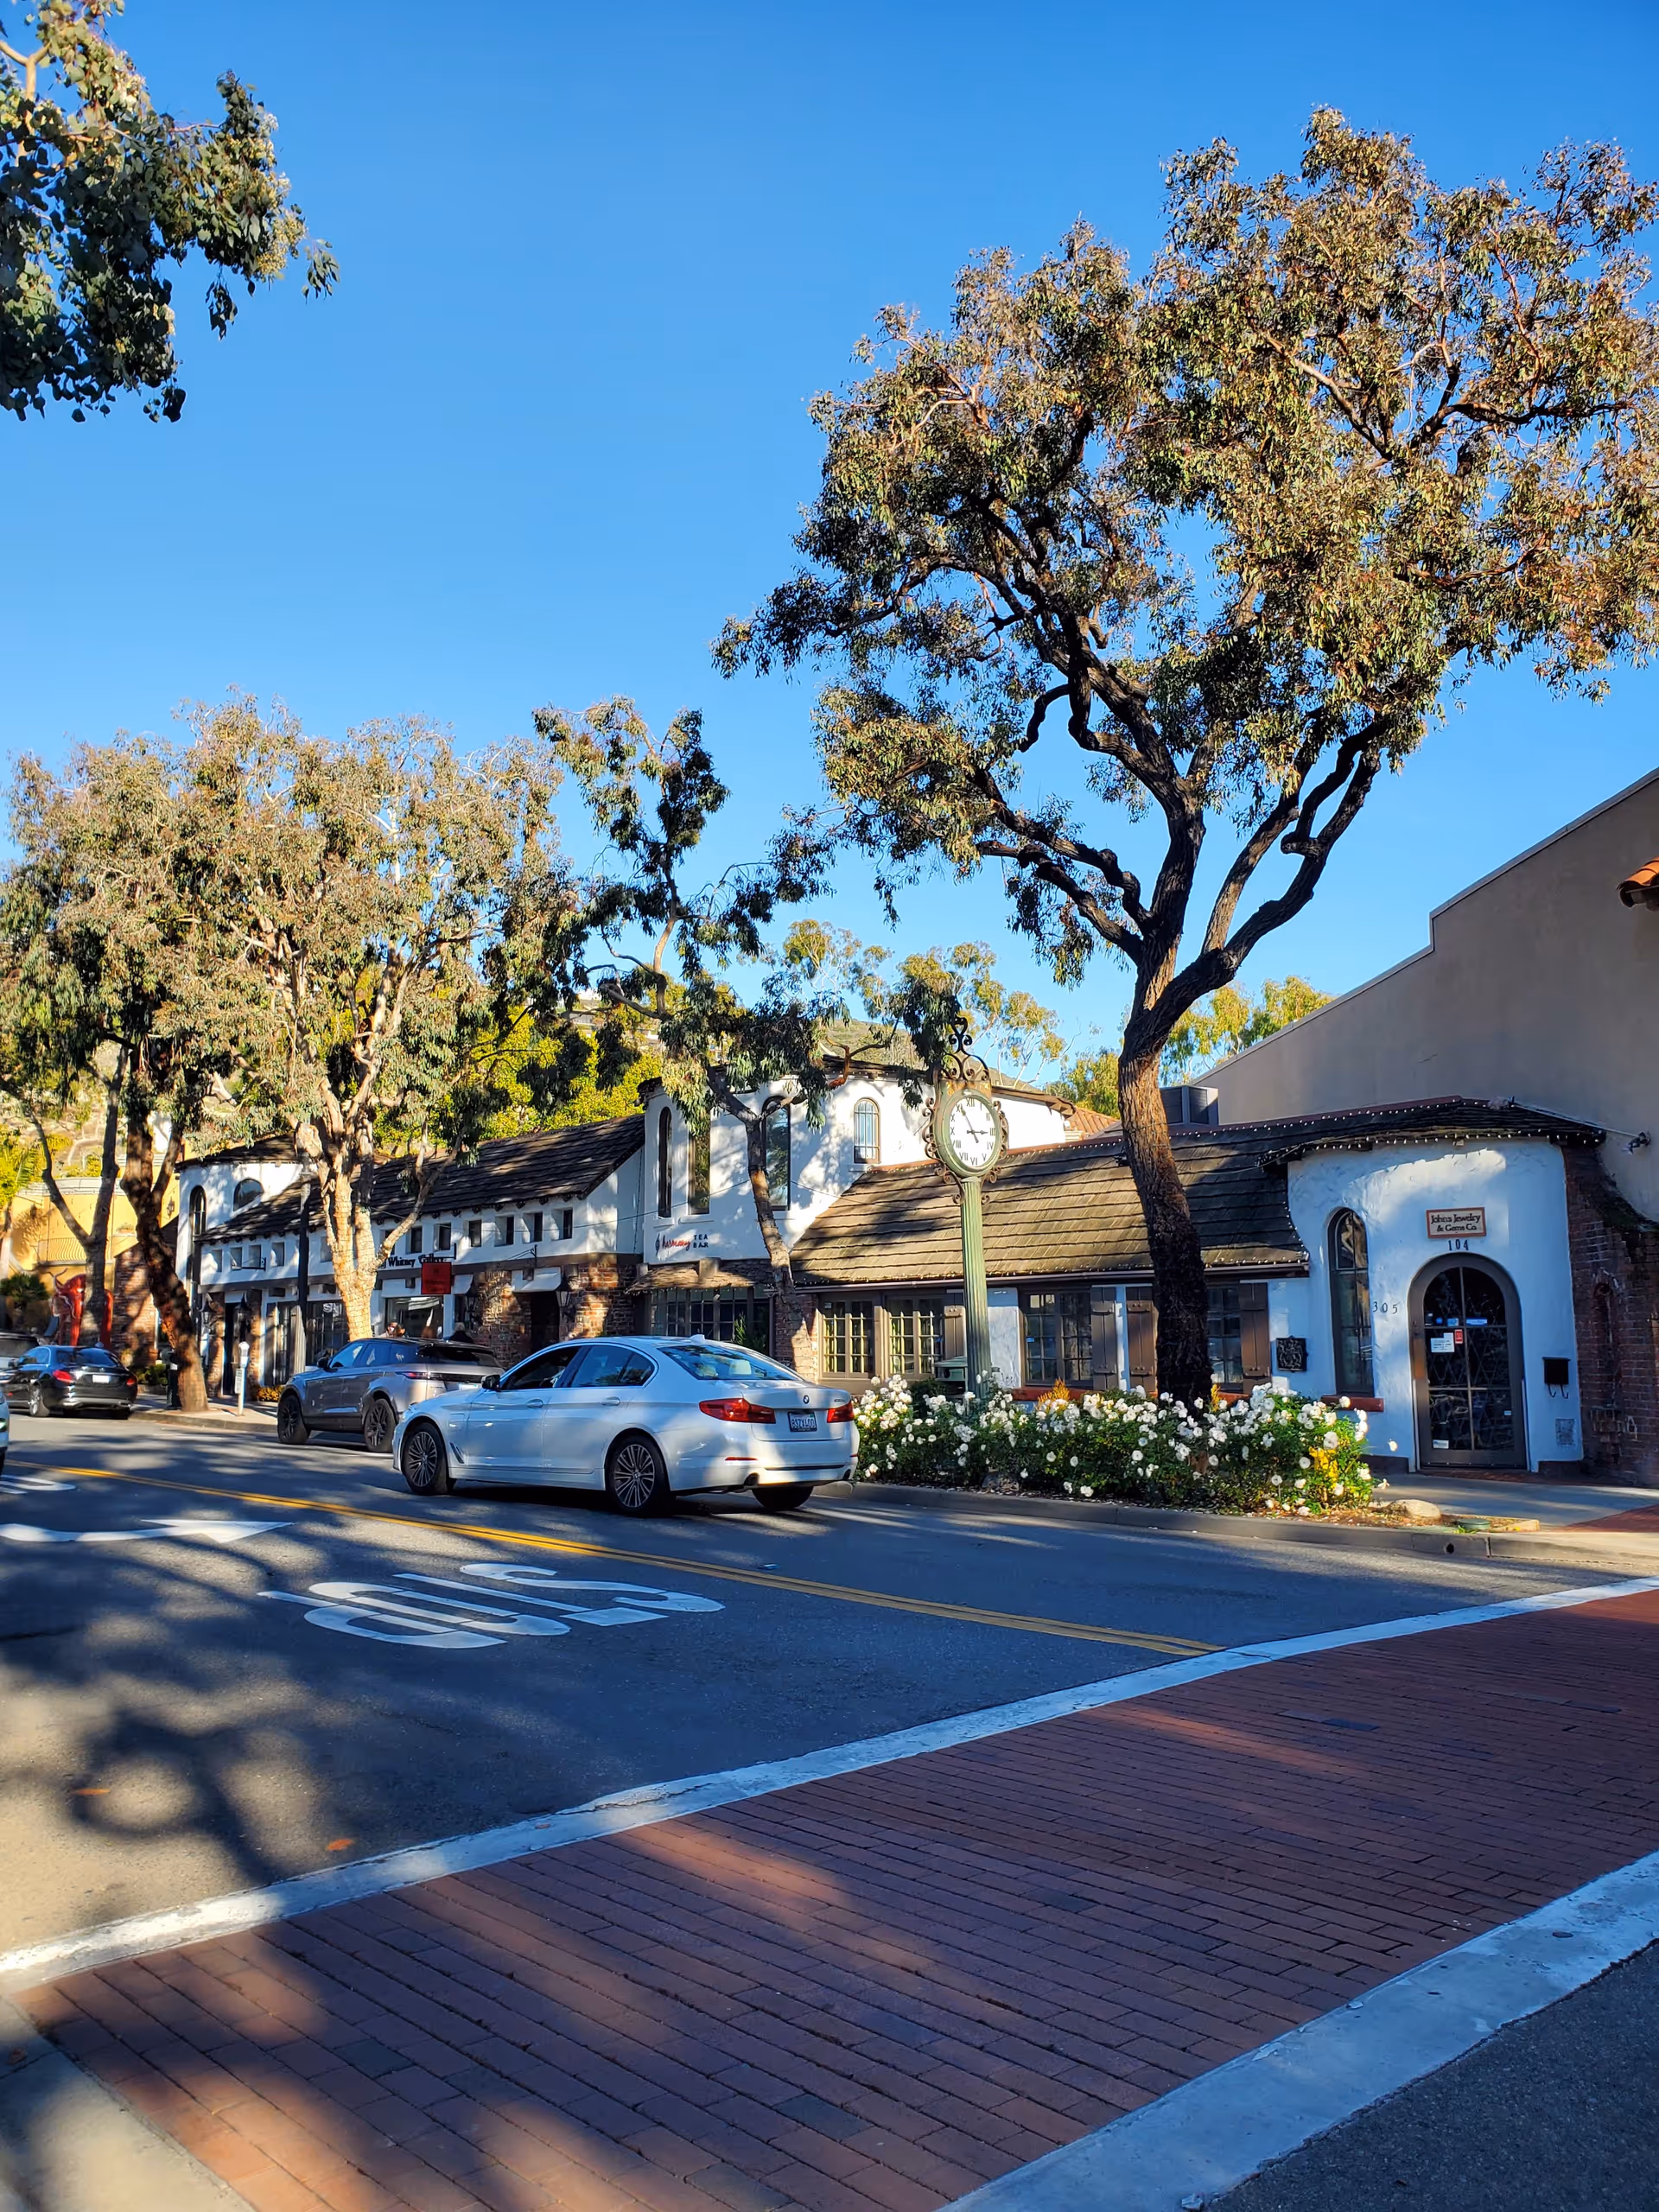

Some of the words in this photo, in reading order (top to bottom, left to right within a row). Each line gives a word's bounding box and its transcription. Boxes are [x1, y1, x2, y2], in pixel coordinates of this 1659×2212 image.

[662, 1235, 690, 1251] harmony
[1448, 1238, 1469, 1251] 104
[388, 1256, 416, 1268] Whitney
[1373, 1301, 1397, 1314] 305
[257, 1563, 725, 1648] STOP
